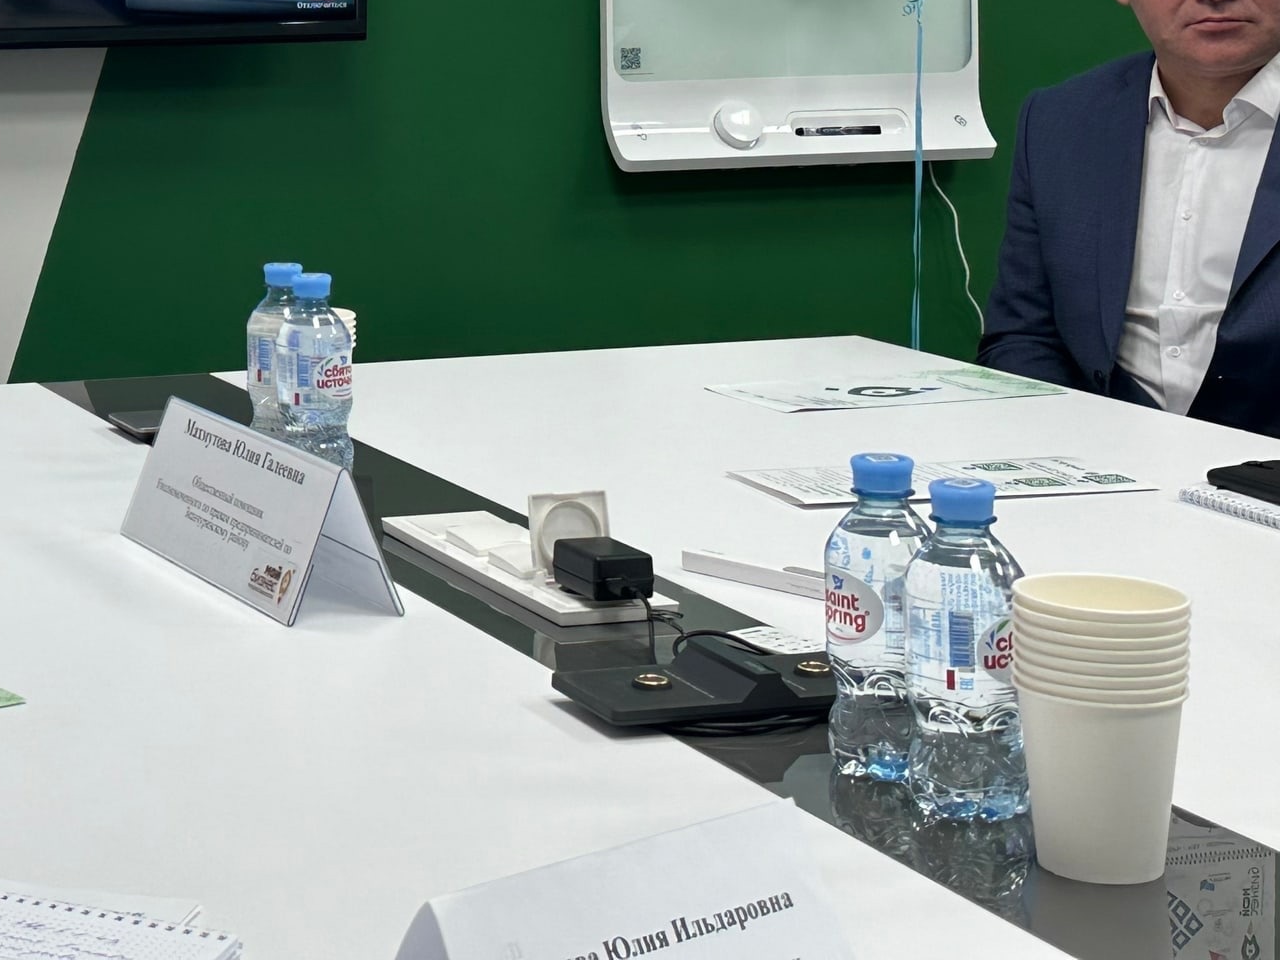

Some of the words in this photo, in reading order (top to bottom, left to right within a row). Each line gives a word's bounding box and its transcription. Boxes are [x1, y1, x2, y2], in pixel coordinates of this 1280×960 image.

[232, 439, 261, 466] Юлия
[261, 451, 306, 485] Галеевна
[602, 929, 670, 960] Юлия
[671, 891, 794, 943] Ильдаровна
